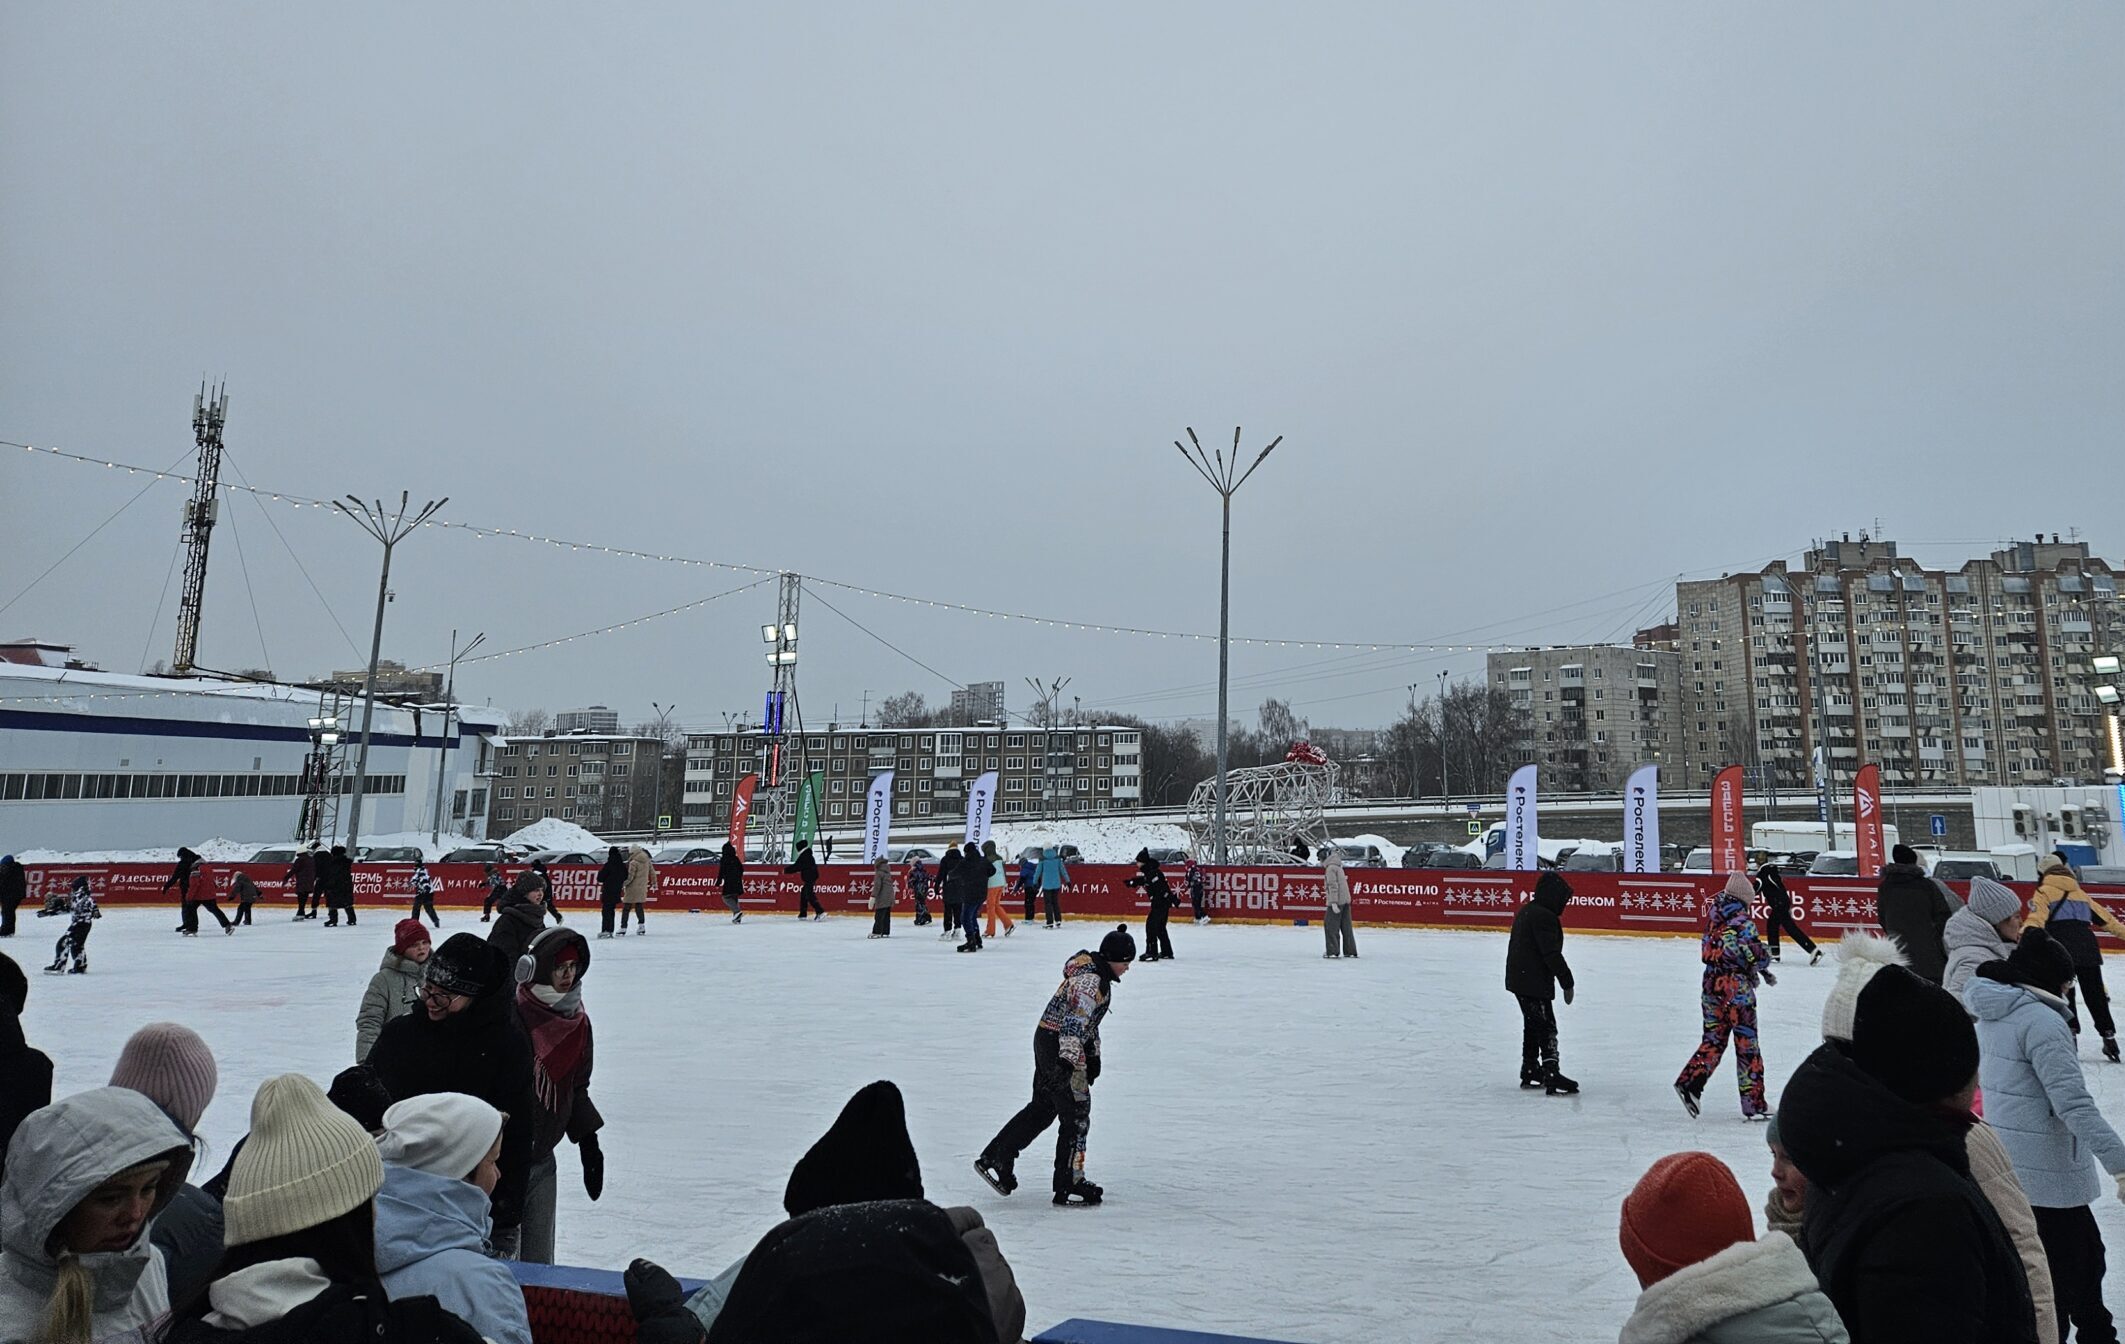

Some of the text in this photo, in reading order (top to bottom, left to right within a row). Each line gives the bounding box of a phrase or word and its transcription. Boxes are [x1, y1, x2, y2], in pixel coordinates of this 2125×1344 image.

[871, 799, 883, 864] Ростелек
[973, 798, 985, 850] Ростел
[1721, 781, 1736, 875] ЗДЕСЬ ТЕП
[1515, 796, 1525, 871] Ростелеко
[1634, 797, 1645, 873] Ростелеко
[1867, 823, 1881, 877] МАГМ
[111, 873, 169, 884] #здесьтеп
[253, 880, 283, 889] елеком
[551, 869, 604, 885] ЭКСП
[1203, 872, 1279, 891] ЭКСПО
[352, 883, 382, 894] КСПО
[786, 882, 845, 893] Рослеком
[1061, 883, 1109, 894] МАГМА
[1353, 882, 1439, 896] #здесьтепло
[1201, 890, 1279, 910] КАТОК
[1529, 891, 1615, 907] Рлеком
